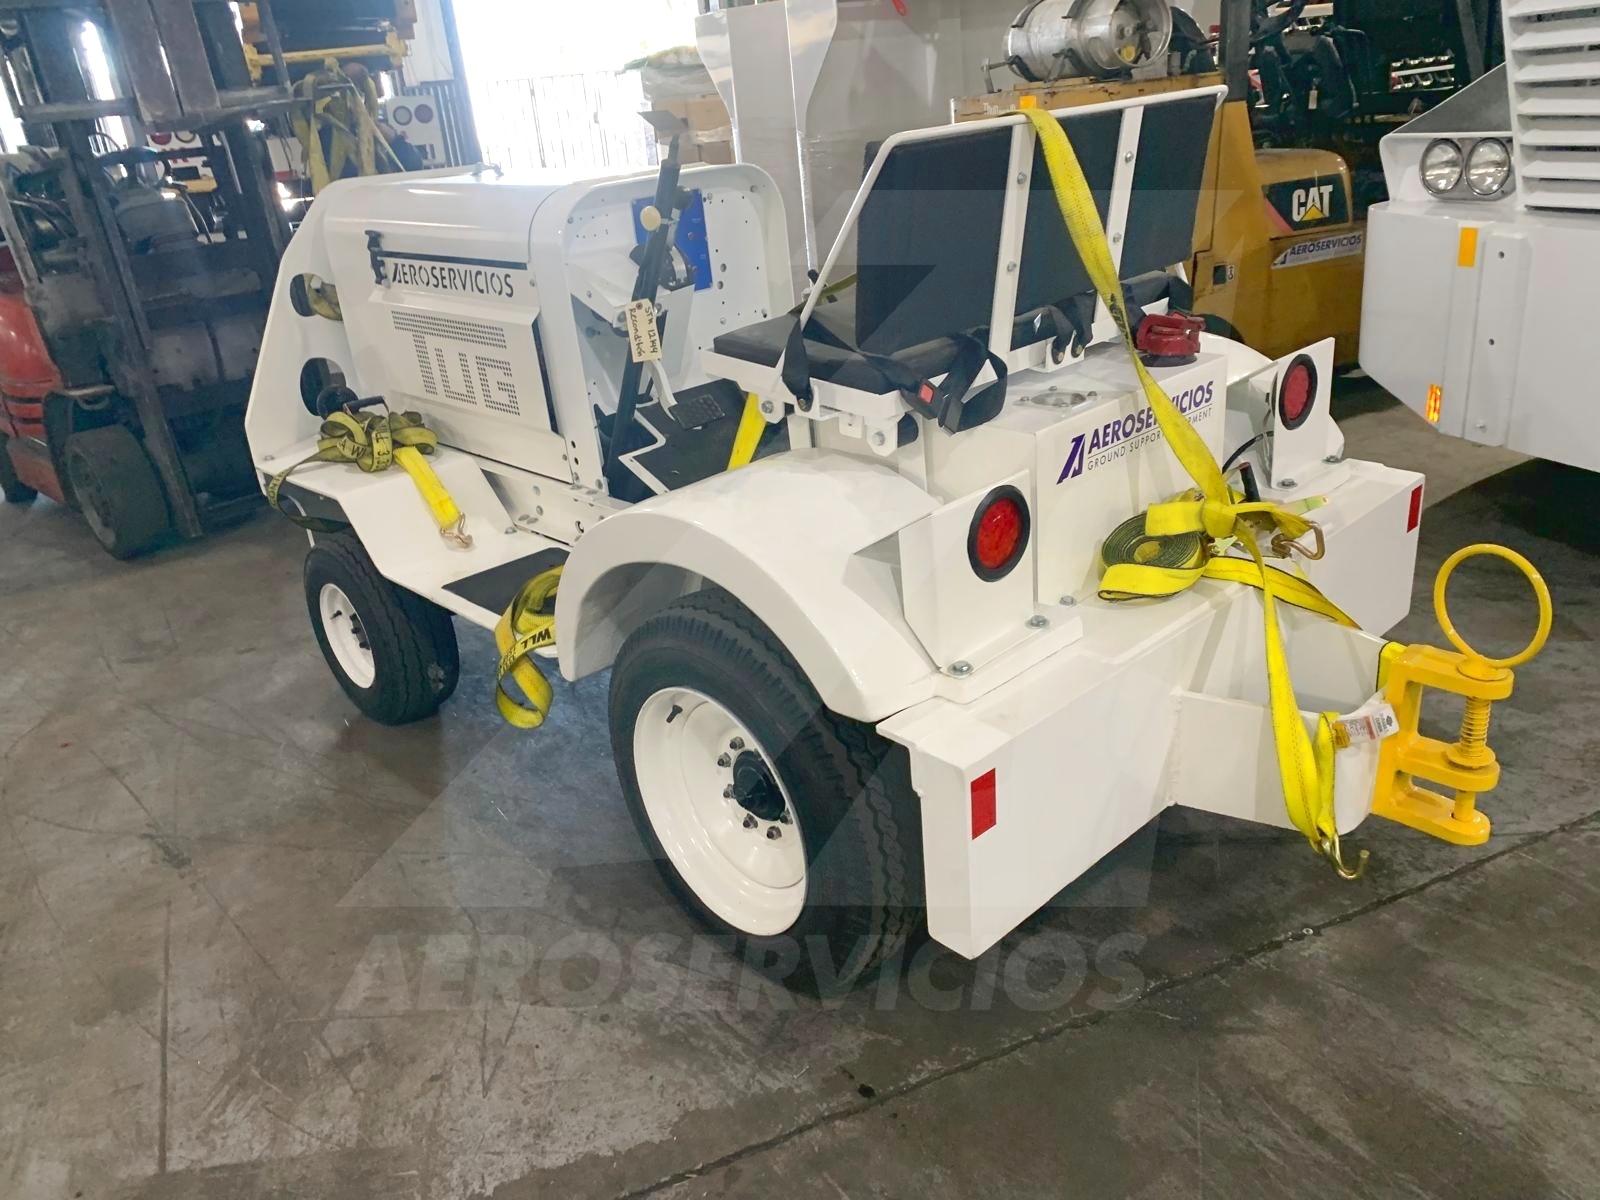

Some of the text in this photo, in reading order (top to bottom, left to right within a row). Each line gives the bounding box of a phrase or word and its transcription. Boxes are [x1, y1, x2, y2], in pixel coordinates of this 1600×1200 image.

[1291, 185, 1334, 222] CAT
[1289, 234, 1362, 256] AEROSERVICIOS
[392, 262, 514, 298] AEROSERVICIOS
[391, 310, 521, 416] TUG
[1087, 380, 1214, 455] AEROSEICIOS
[1087, 447, 1126, 471] GROUND
[1129, 430, 1165, 453] SUPPOR
[520, 628, 551, 650] WLL
